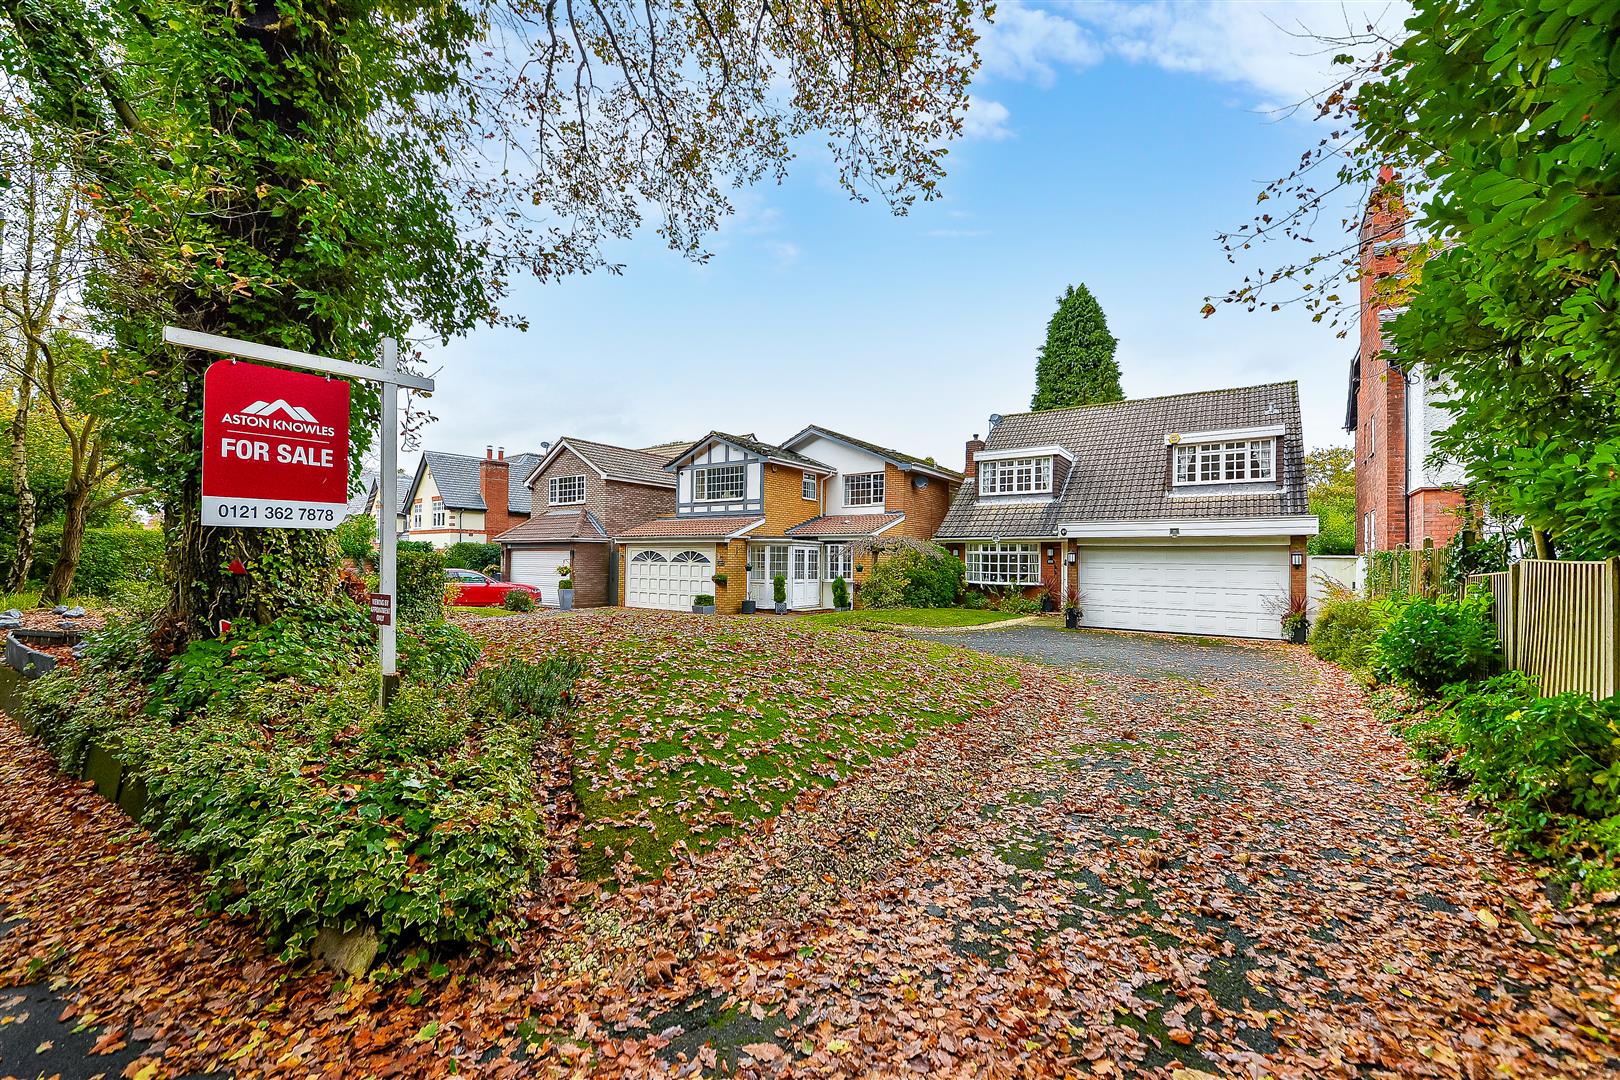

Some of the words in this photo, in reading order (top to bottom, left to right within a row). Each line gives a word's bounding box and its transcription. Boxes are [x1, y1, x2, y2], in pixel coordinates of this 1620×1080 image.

[221, 412, 270, 428] ASTON
[273, 420, 335, 437] KNOWLES
[221, 437, 270, 461] FOR
[277, 444, 334, 468] SALE
[218, 504, 258, 519] 0121
[264, 506, 294, 520] 362
[298, 508, 334, 522] 7878
